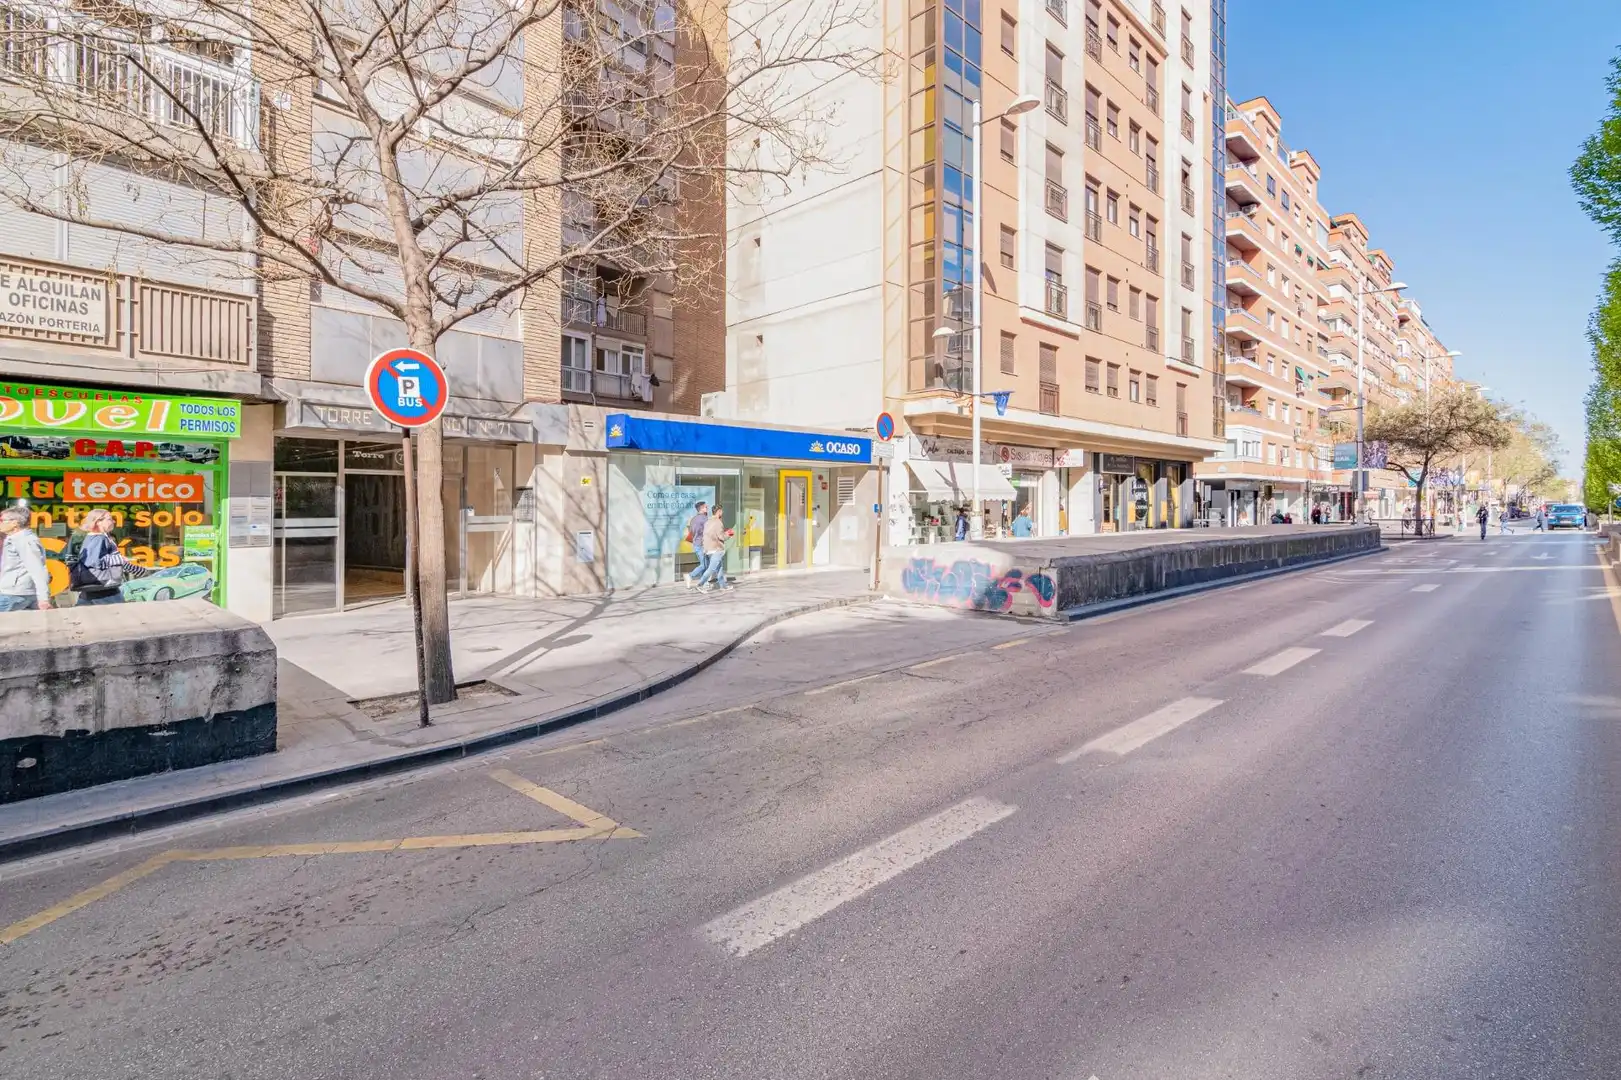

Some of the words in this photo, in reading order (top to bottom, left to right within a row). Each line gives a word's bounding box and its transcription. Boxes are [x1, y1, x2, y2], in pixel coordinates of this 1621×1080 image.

[17, 277, 101, 301] ALQUILAN
[8, 292, 88, 315] OFICINAS
[40, 316, 100, 332] PORTERIA
[402, 380, 415, 395] P
[180, 404, 214, 415] TODOS
[217, 406, 236, 416] LOS
[398, 397, 423, 407] BUS
[317, 406, 373, 425] TORRE
[180, 418, 236, 433] PERMISOS
[74, 438, 157, 458] C.A.P.
[352, 450, 385, 459] Torre
[826, 441, 861, 455] OCASO
[72, 477, 195, 499] teórico
[134, 506, 203, 527] solo
